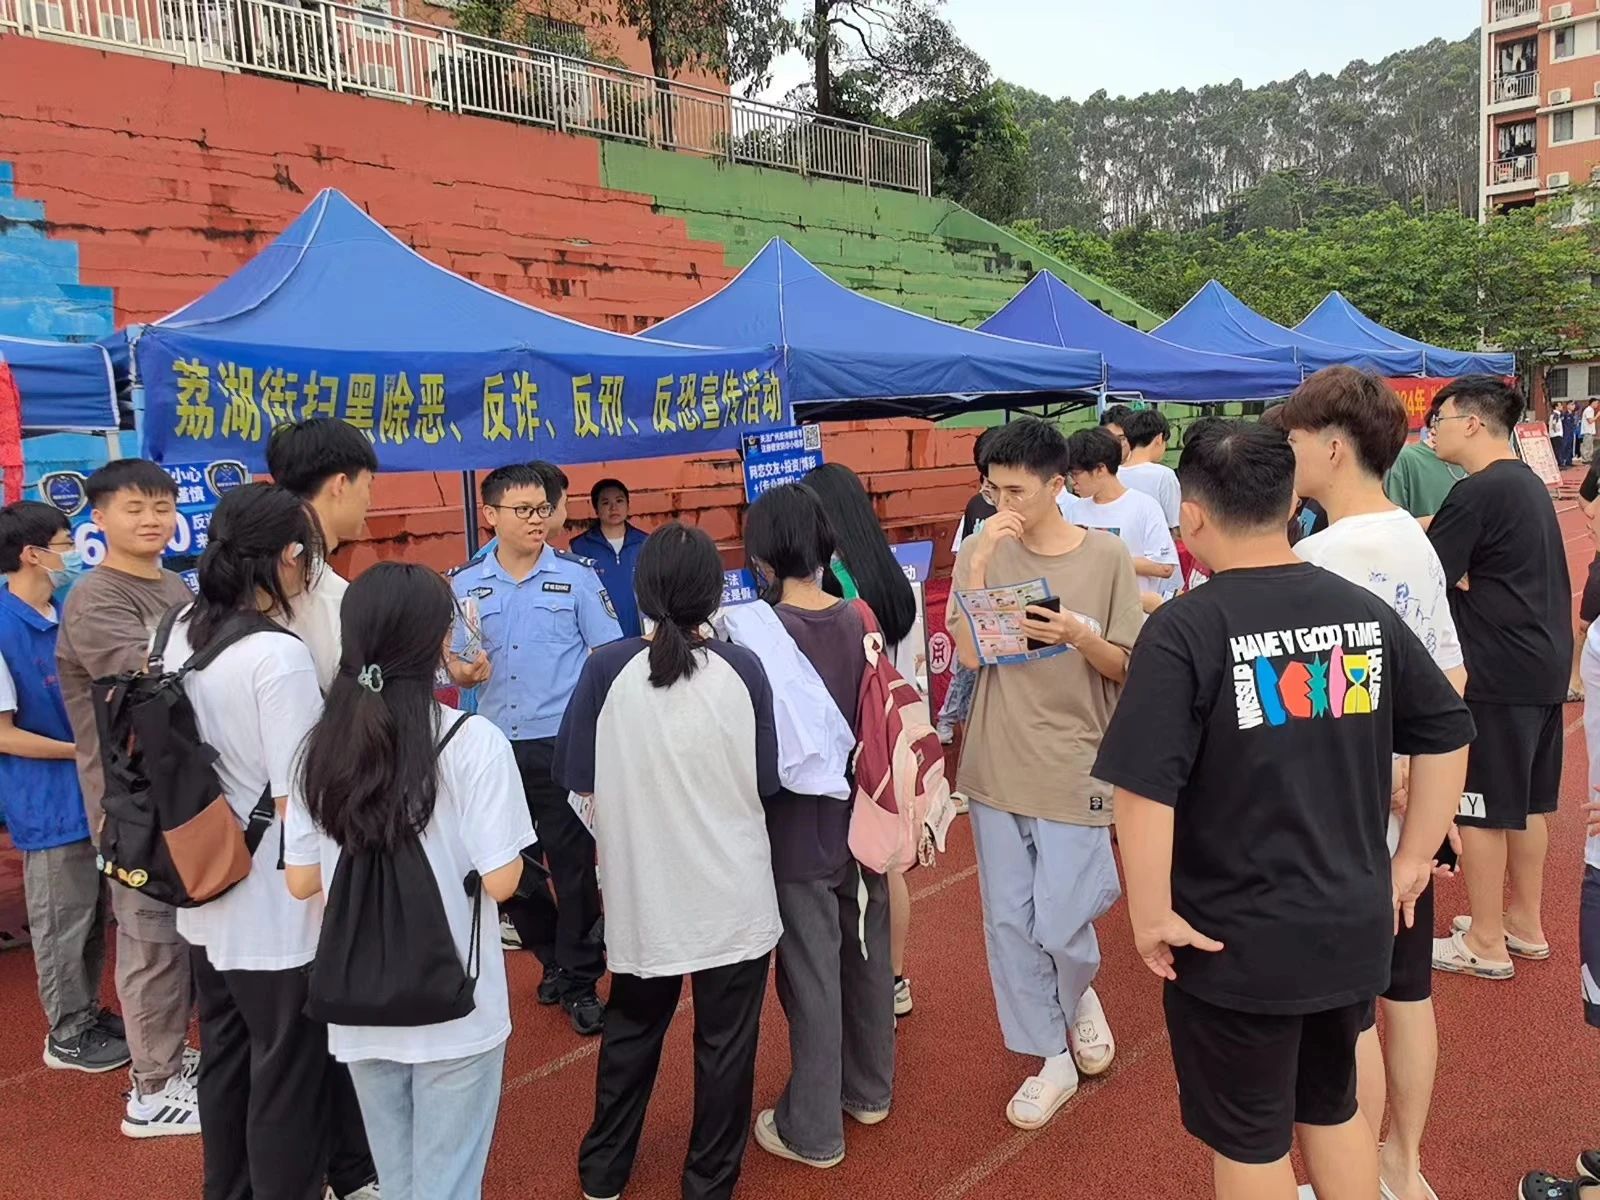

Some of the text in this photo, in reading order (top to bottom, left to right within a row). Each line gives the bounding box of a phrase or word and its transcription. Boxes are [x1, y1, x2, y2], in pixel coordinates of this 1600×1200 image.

[172, 353, 782, 444] 荔湖街扫黑除恶、反诈、反邪、反恐宣传活动
[1230, 631, 1283, 662] HAVE
[1295, 624, 1343, 653] GOOD
[1343, 621, 1383, 648] TIME
